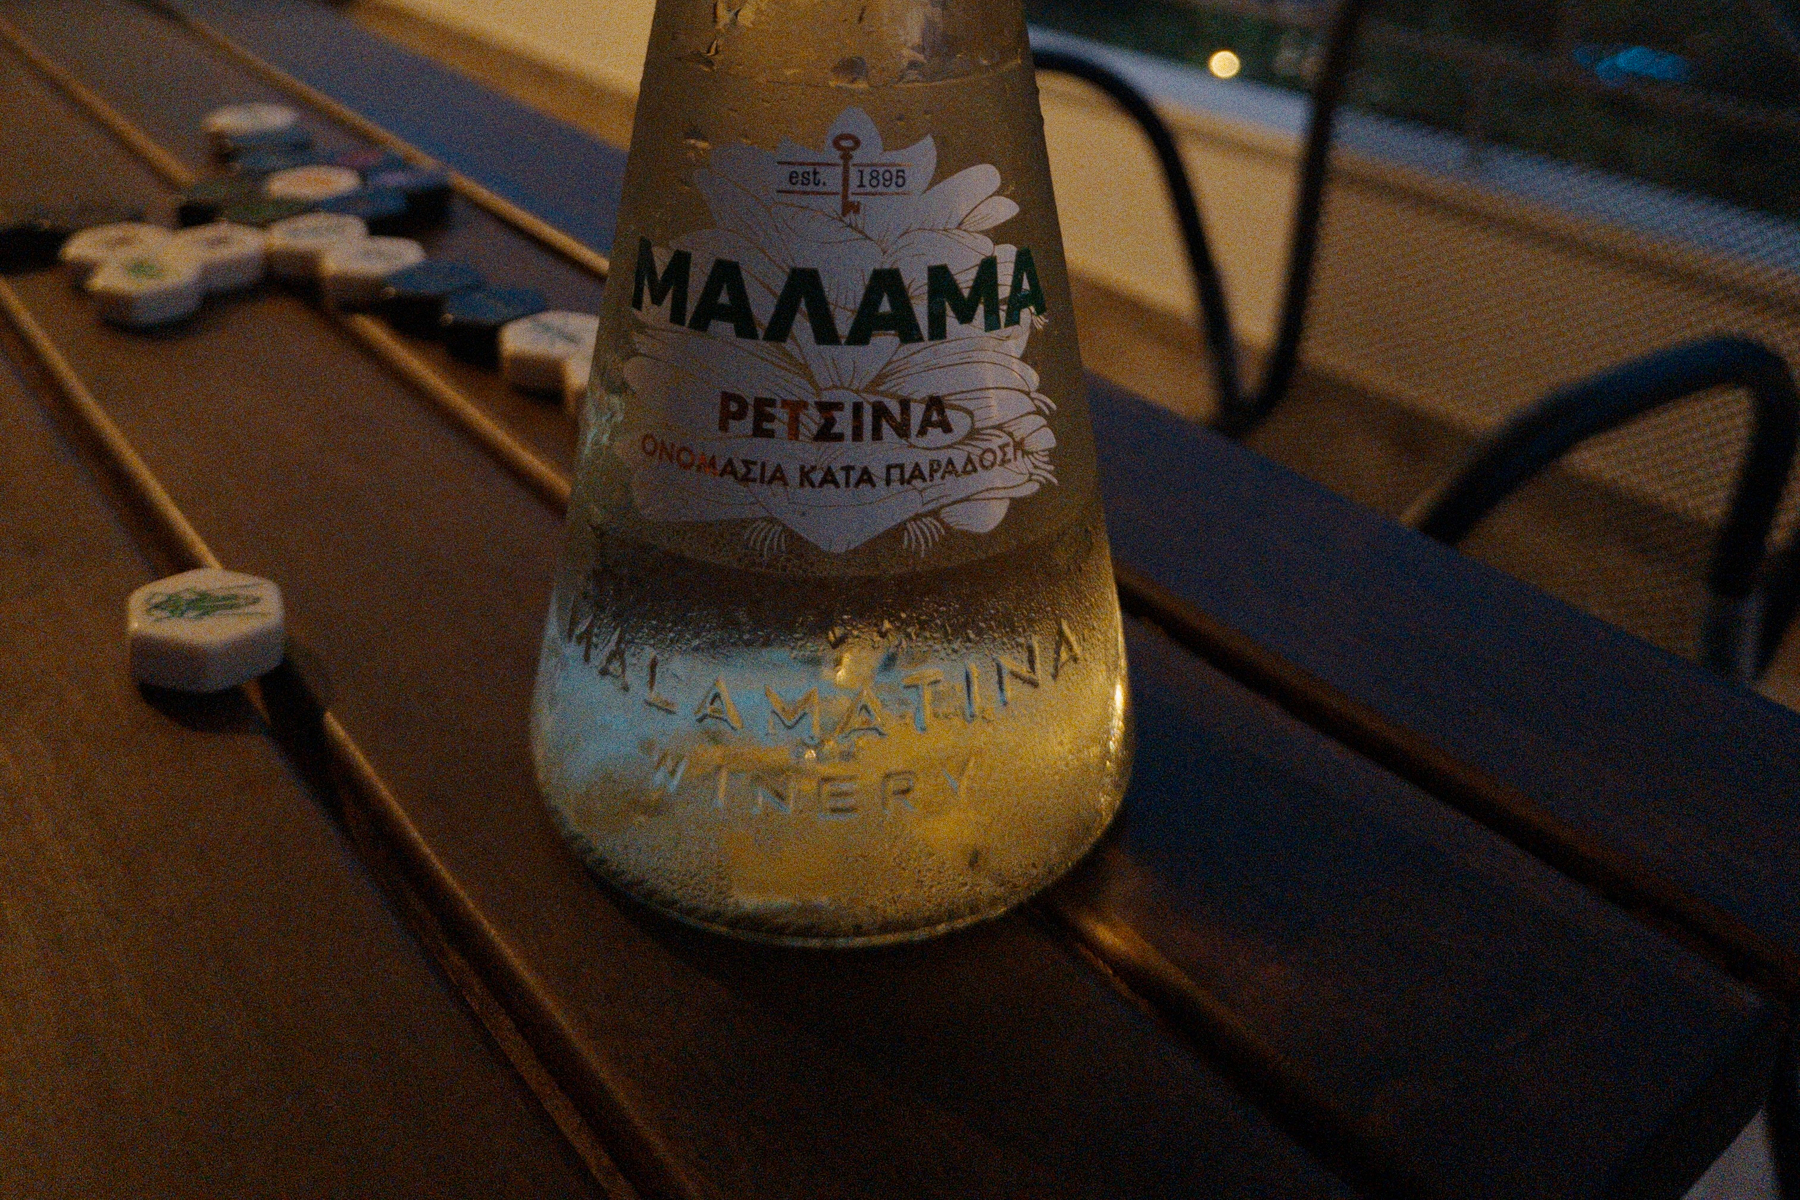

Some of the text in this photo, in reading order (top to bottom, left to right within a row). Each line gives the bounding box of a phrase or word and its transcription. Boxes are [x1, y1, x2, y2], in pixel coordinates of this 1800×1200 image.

[788, 166, 907, 189] est. 1895
[631, 236, 1048, 347] ΜΑΛΑΜΑ
[717, 391, 954, 442] ΡΕΤΣΙΝΑ
[640, 433, 790, 488] ΟΝΟΜΑΣΙΑ
[798, 463, 878, 490] ΚΑΤΑ
